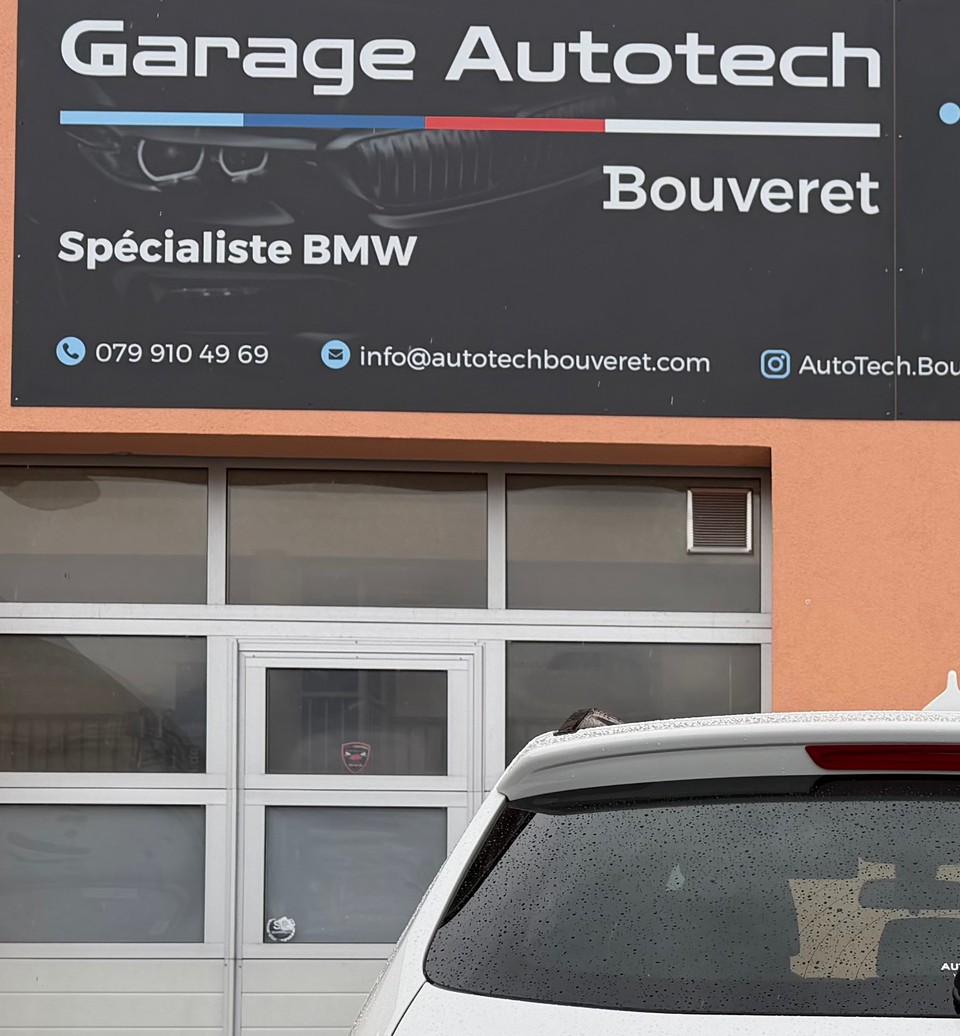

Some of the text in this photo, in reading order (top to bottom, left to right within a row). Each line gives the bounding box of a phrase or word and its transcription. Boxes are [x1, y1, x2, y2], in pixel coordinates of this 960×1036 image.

[60, 19, 881, 96] Garage Autotech
[602, 165, 880, 215] Bouveret
[57, 228, 418, 270] Spécialiste BMW
[95, 343, 269, 364] 079 910 49 69
[360, 345, 710, 373] info@autotechbouveret.com
